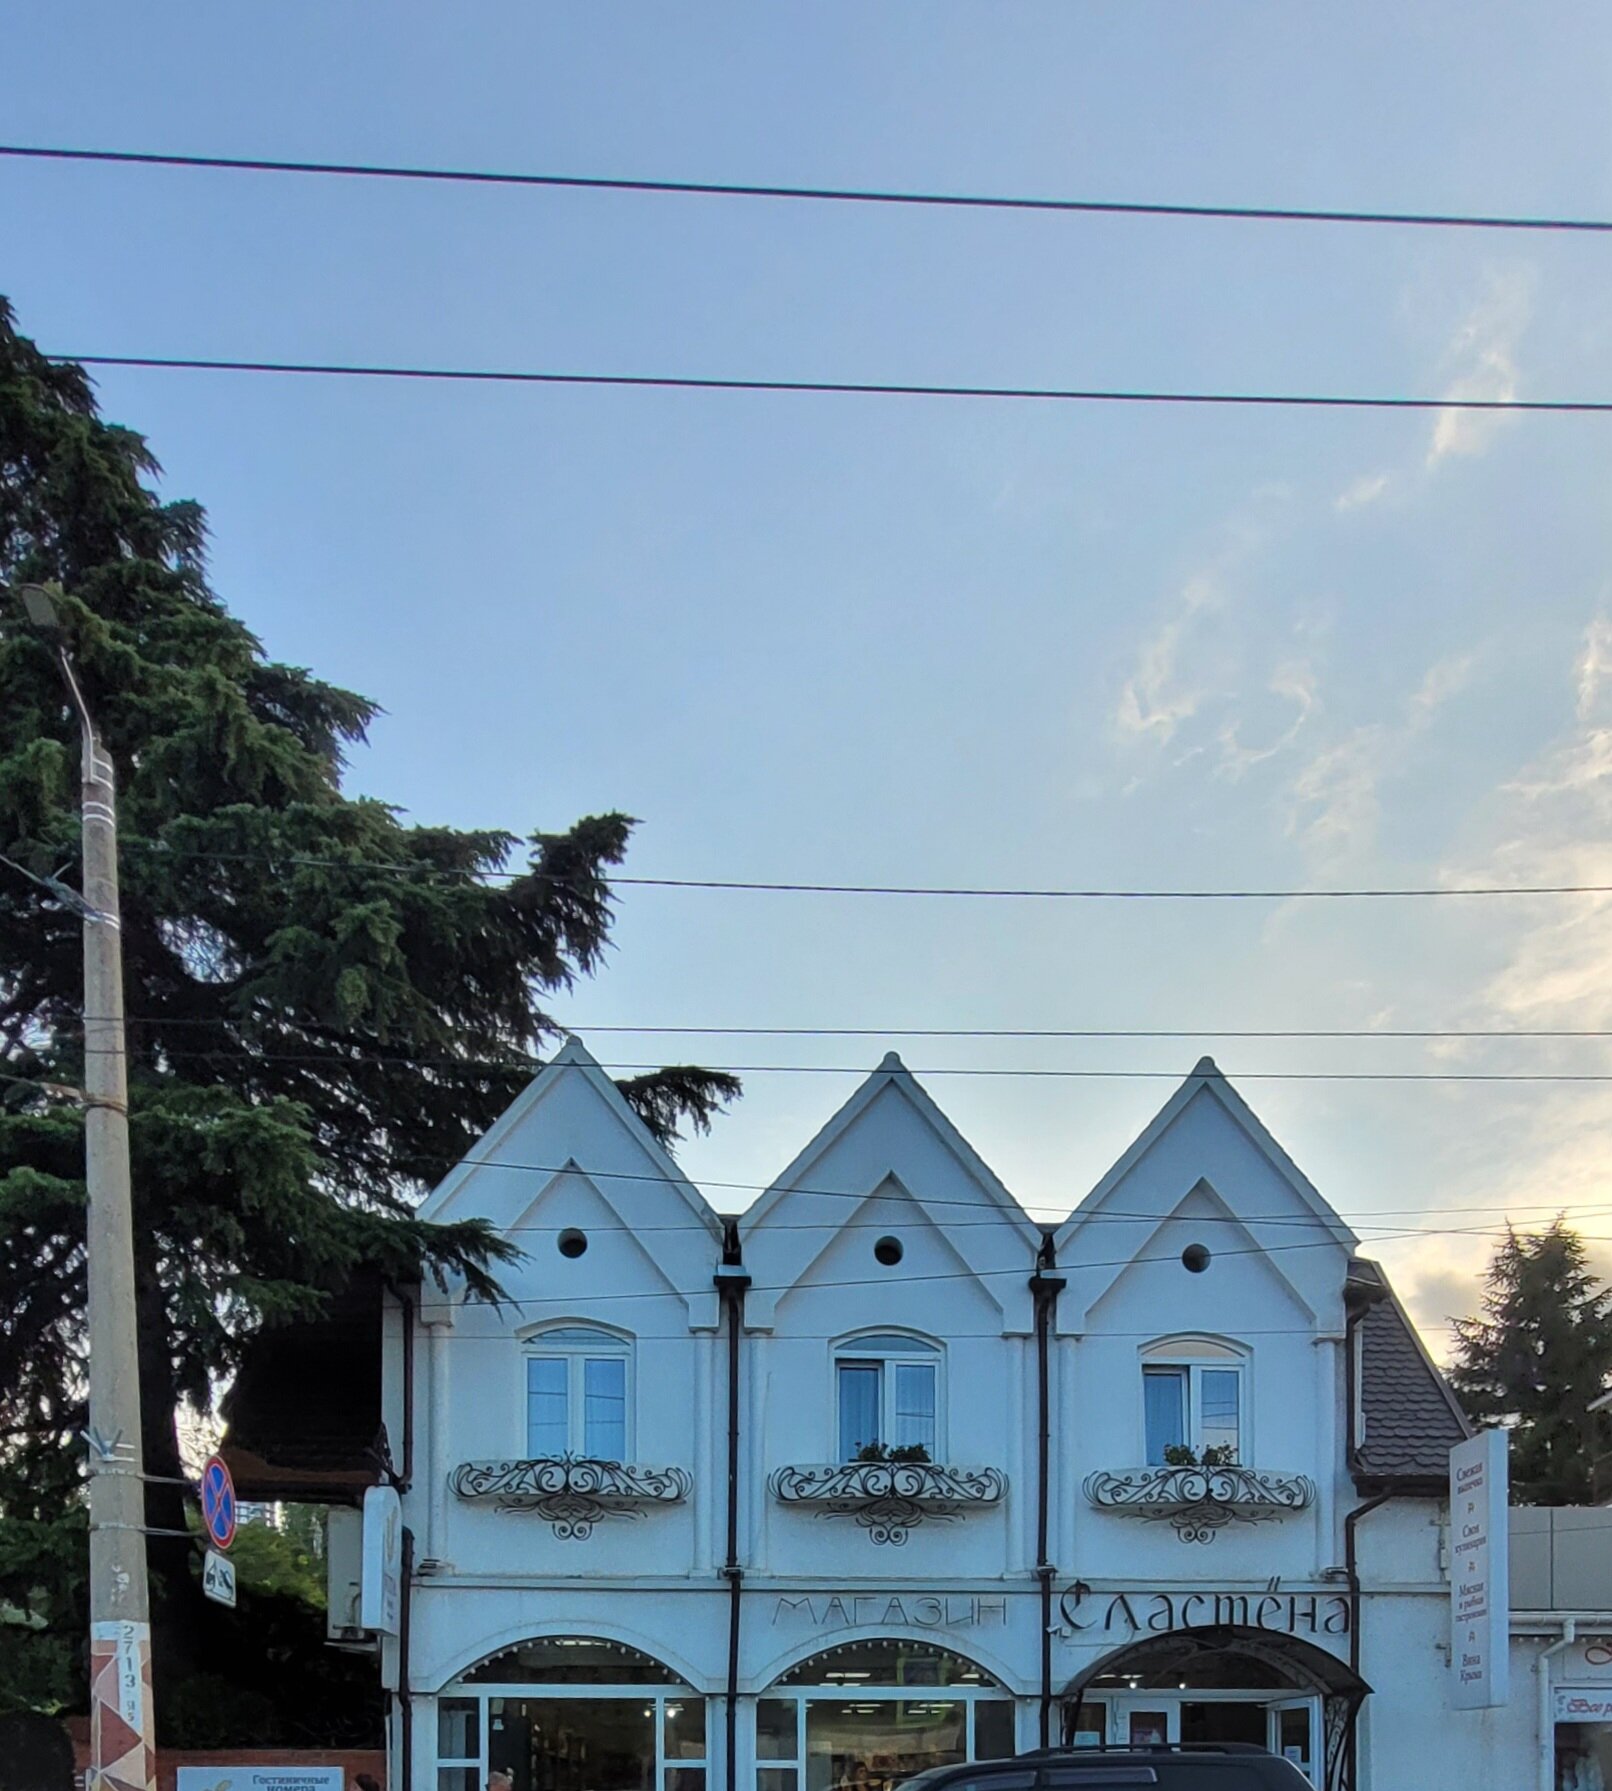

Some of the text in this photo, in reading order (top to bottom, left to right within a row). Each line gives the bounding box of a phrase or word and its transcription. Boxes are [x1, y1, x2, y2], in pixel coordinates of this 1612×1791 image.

[772, 1597, 1006, 1626] МАГАЗИН
[1060, 1576, 1350, 1634] Сластёна
[252, 1774, 330, 1785] Гостиничные
